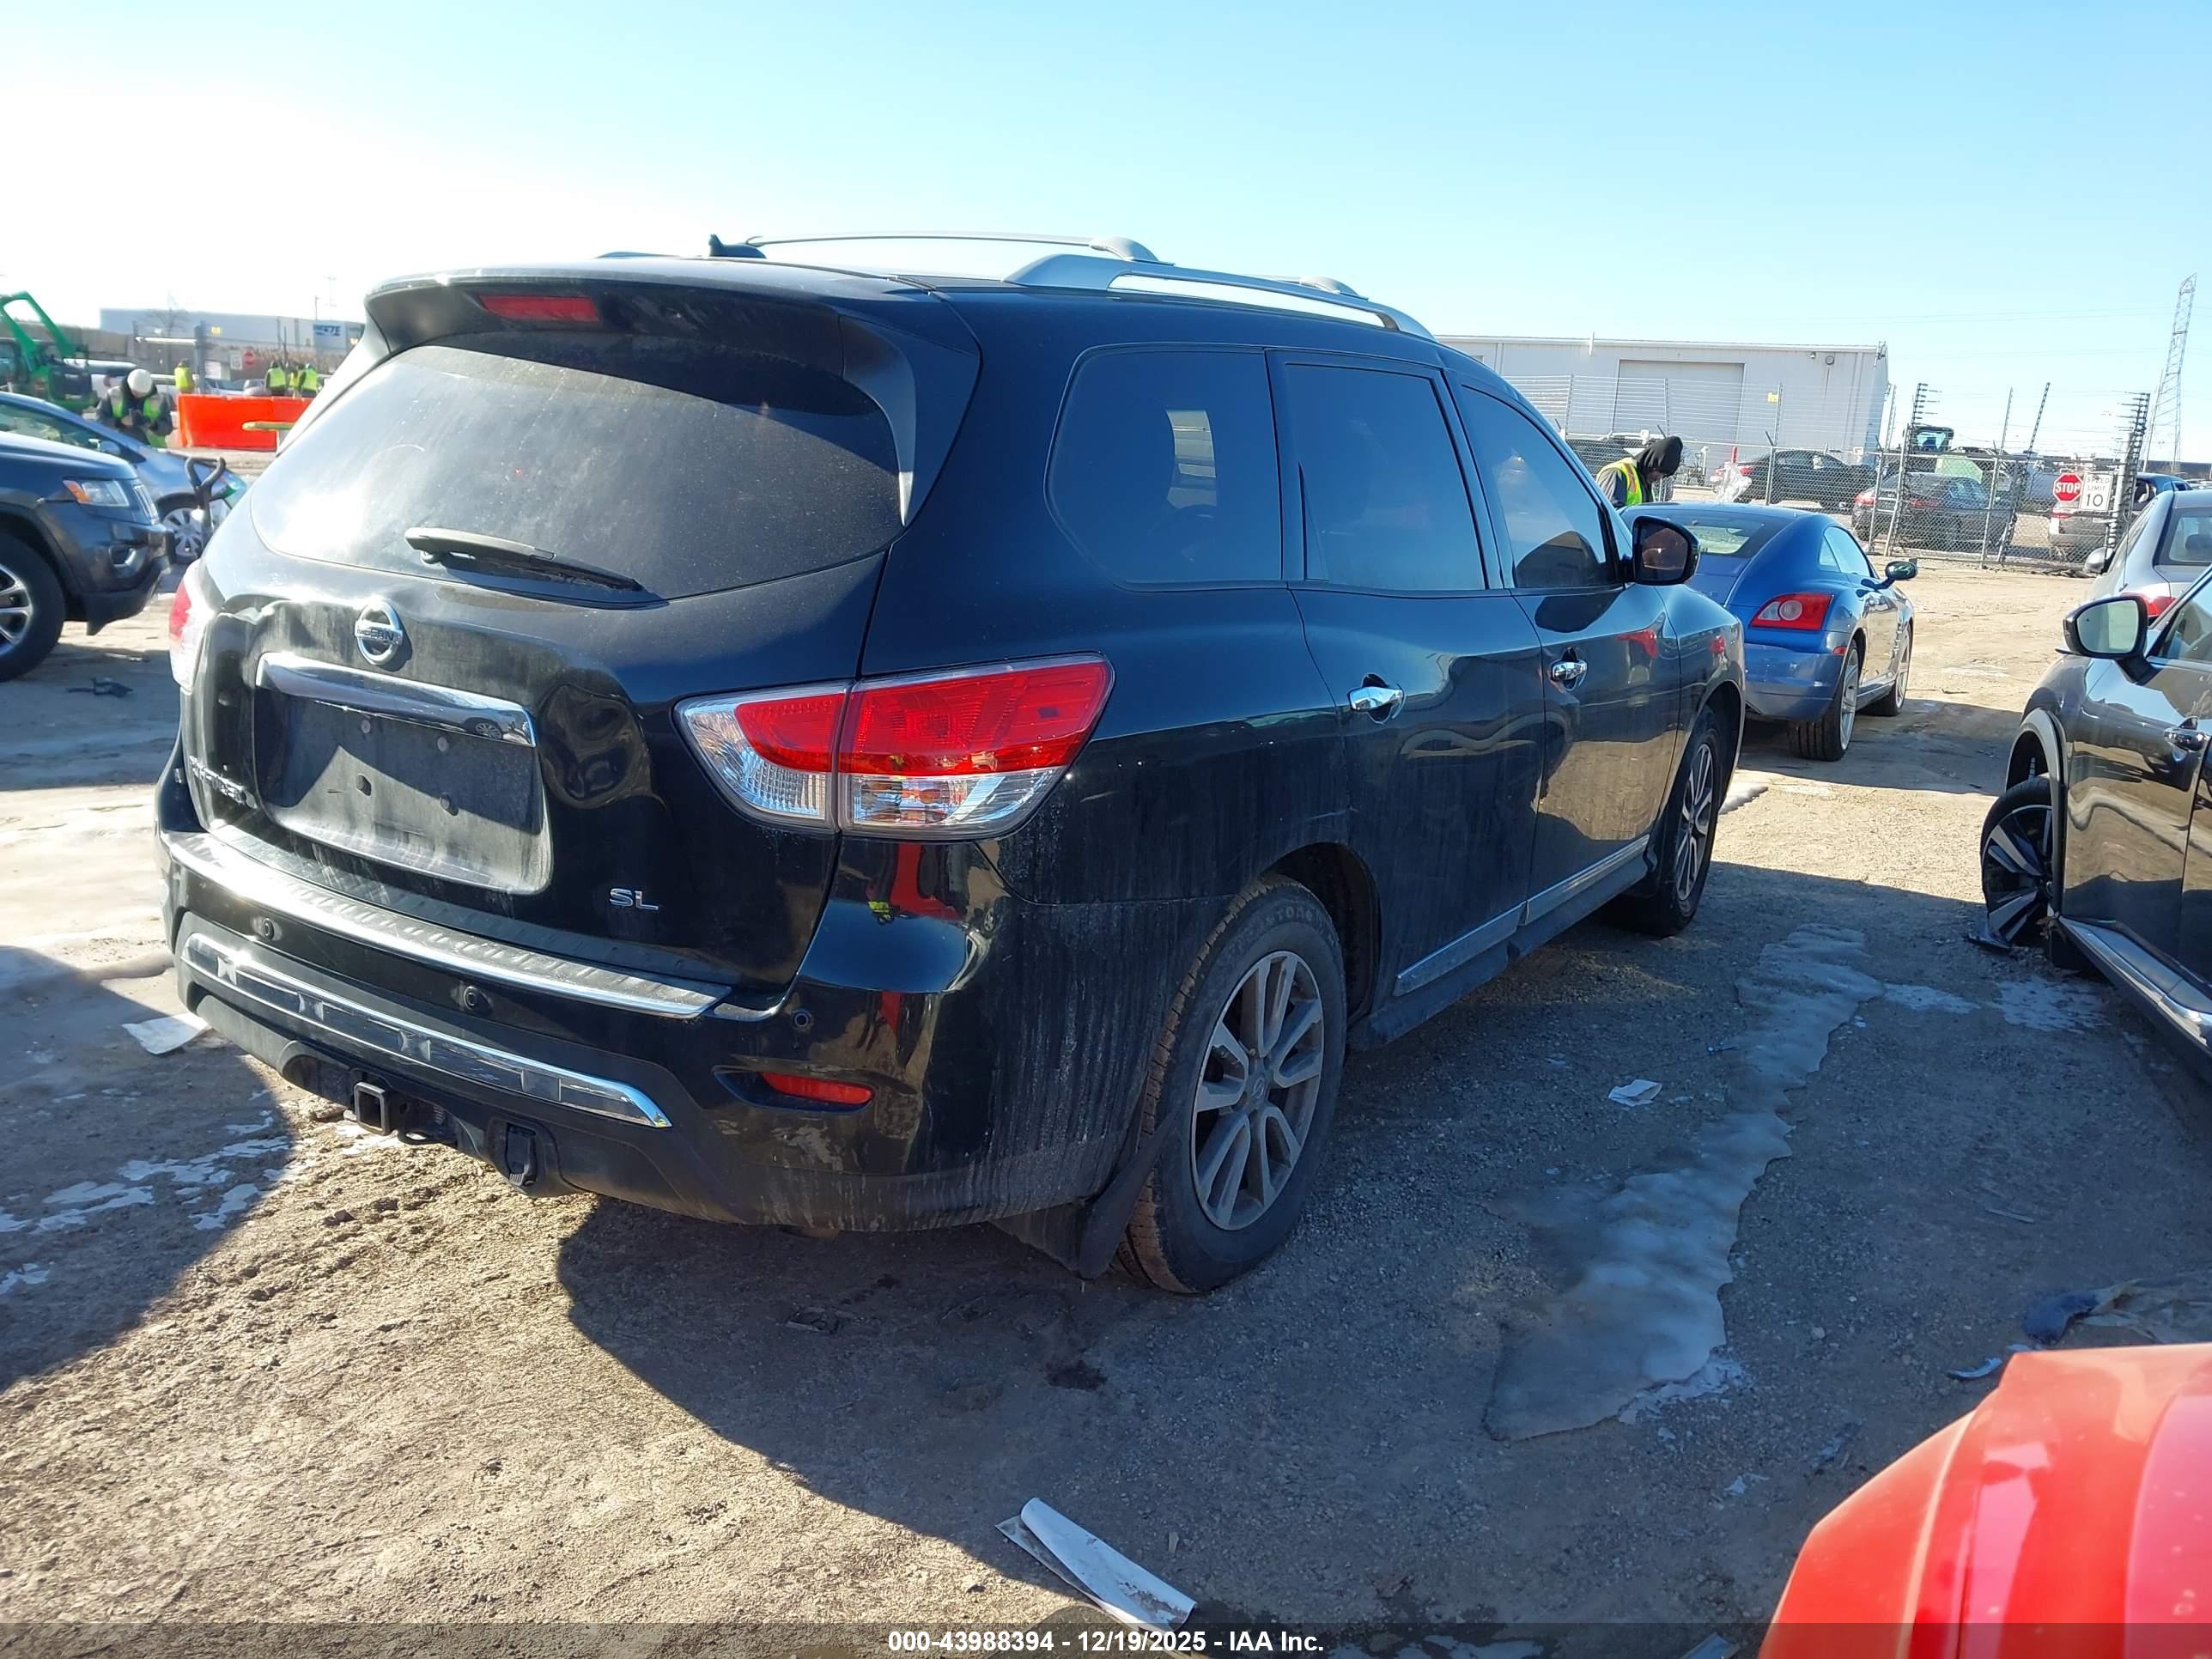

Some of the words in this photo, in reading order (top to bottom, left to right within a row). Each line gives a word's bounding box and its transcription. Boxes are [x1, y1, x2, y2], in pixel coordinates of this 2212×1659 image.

[2055, 482, 2081, 495] STOP
[2087, 493, 2103, 507] 10
[610, 888, 659, 910] SL
